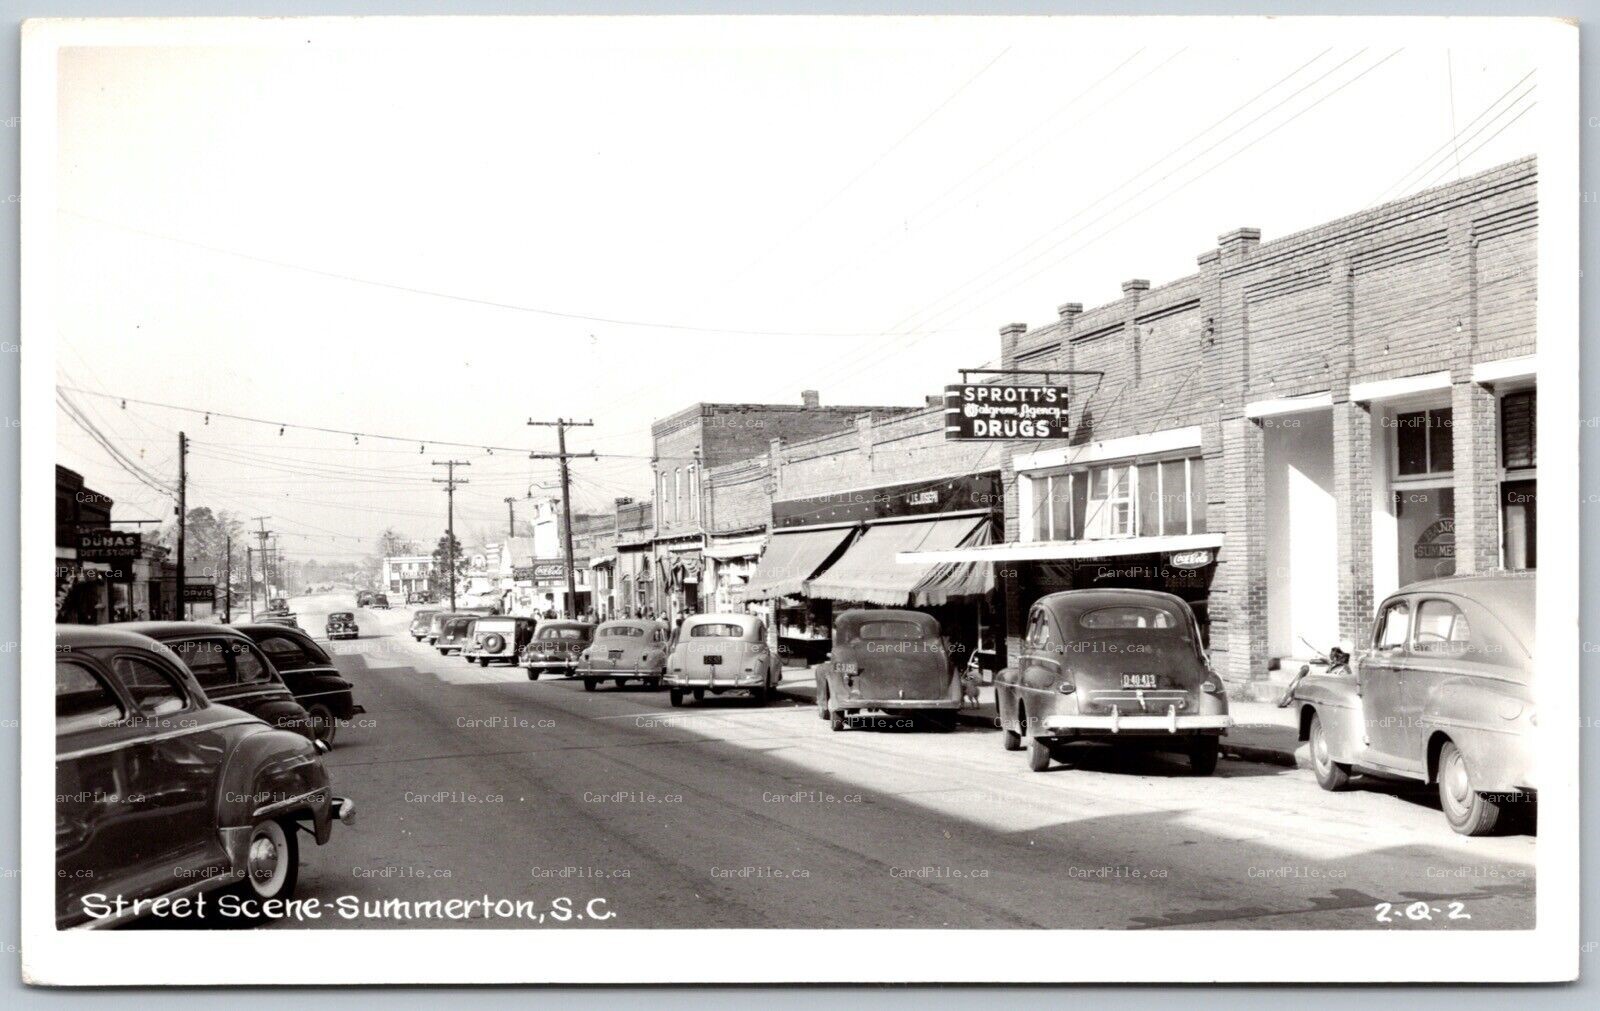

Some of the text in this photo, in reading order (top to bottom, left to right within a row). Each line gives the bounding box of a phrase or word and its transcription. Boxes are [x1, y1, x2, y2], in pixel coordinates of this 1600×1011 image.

[963, 386, 1058, 402] SPROTT'S
[963, 402, 1061, 418] Walgreen Agency
[973, 419, 1050, 437] DRUGS
